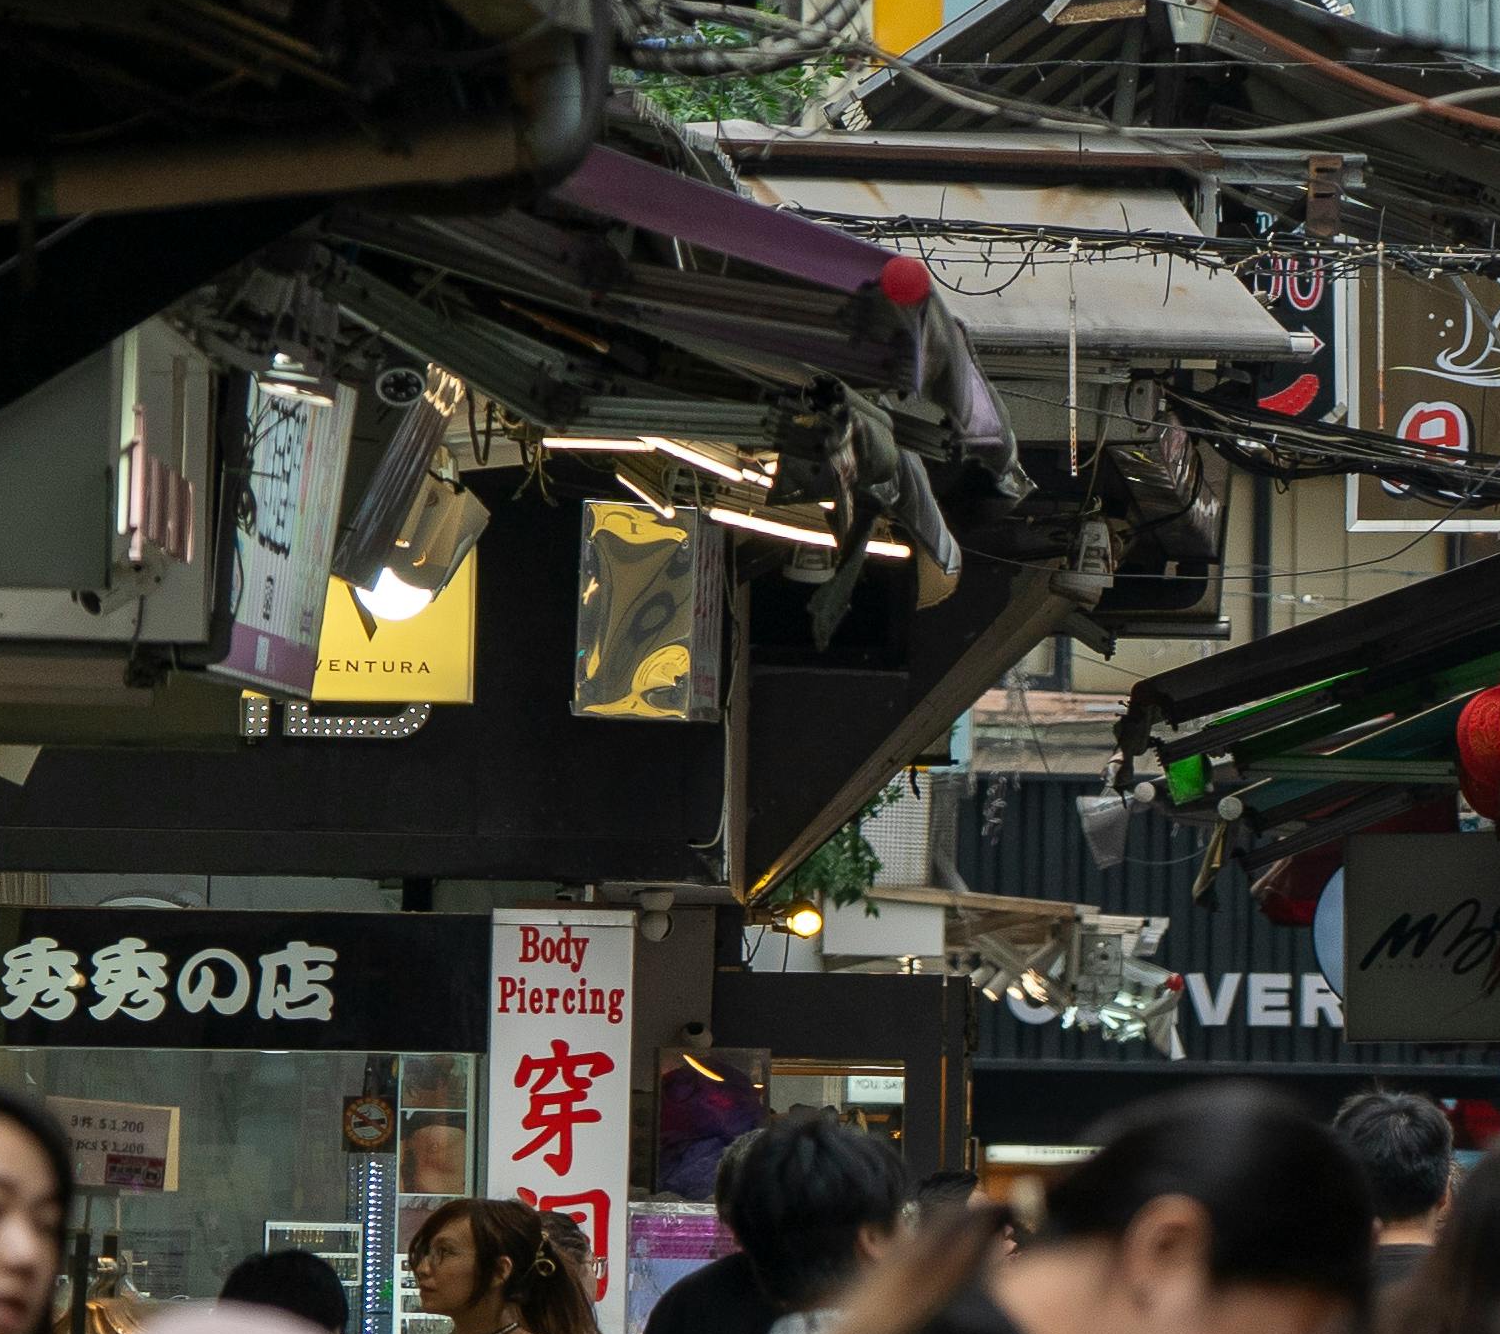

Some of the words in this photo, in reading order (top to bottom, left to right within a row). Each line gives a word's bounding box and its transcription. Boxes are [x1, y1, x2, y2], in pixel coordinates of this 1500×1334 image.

[519, 926, 590, 972] Body
[0, 936, 338, 1022] 秀秀の店
[498, 977, 625, 1025] Piercing
